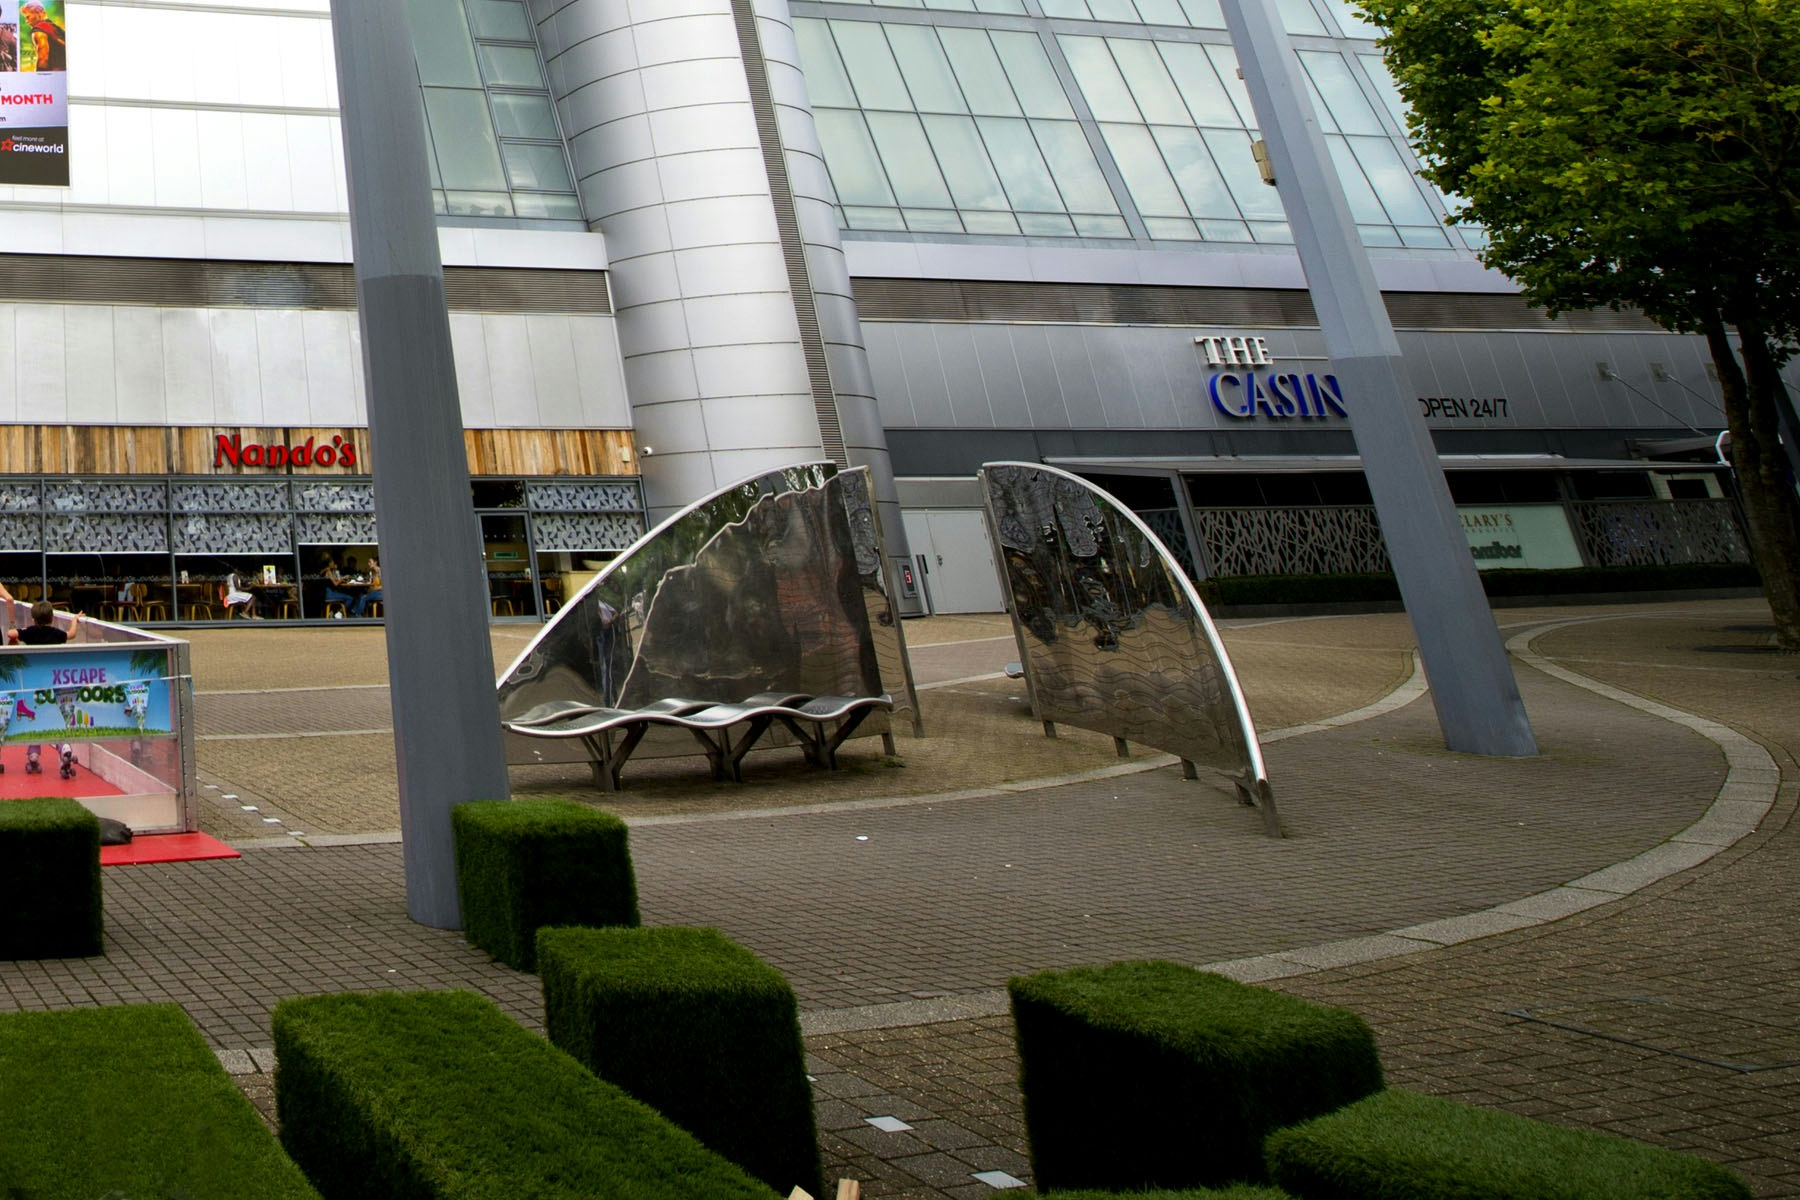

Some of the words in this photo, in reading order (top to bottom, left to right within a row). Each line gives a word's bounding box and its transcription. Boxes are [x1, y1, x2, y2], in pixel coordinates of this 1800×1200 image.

[1, 94, 53, 105] MONTH
[13, 143, 64, 153] cineworld
[1194, 336, 1273, 366] THE
[1209, 372, 1348, 418] CASIN
[1470, 398, 1508, 418] 24/7
[214, 434, 356, 467] Nando's
[52, 668, 106, 684] XSCAPE
[34, 685, 126, 704] OUOORS
